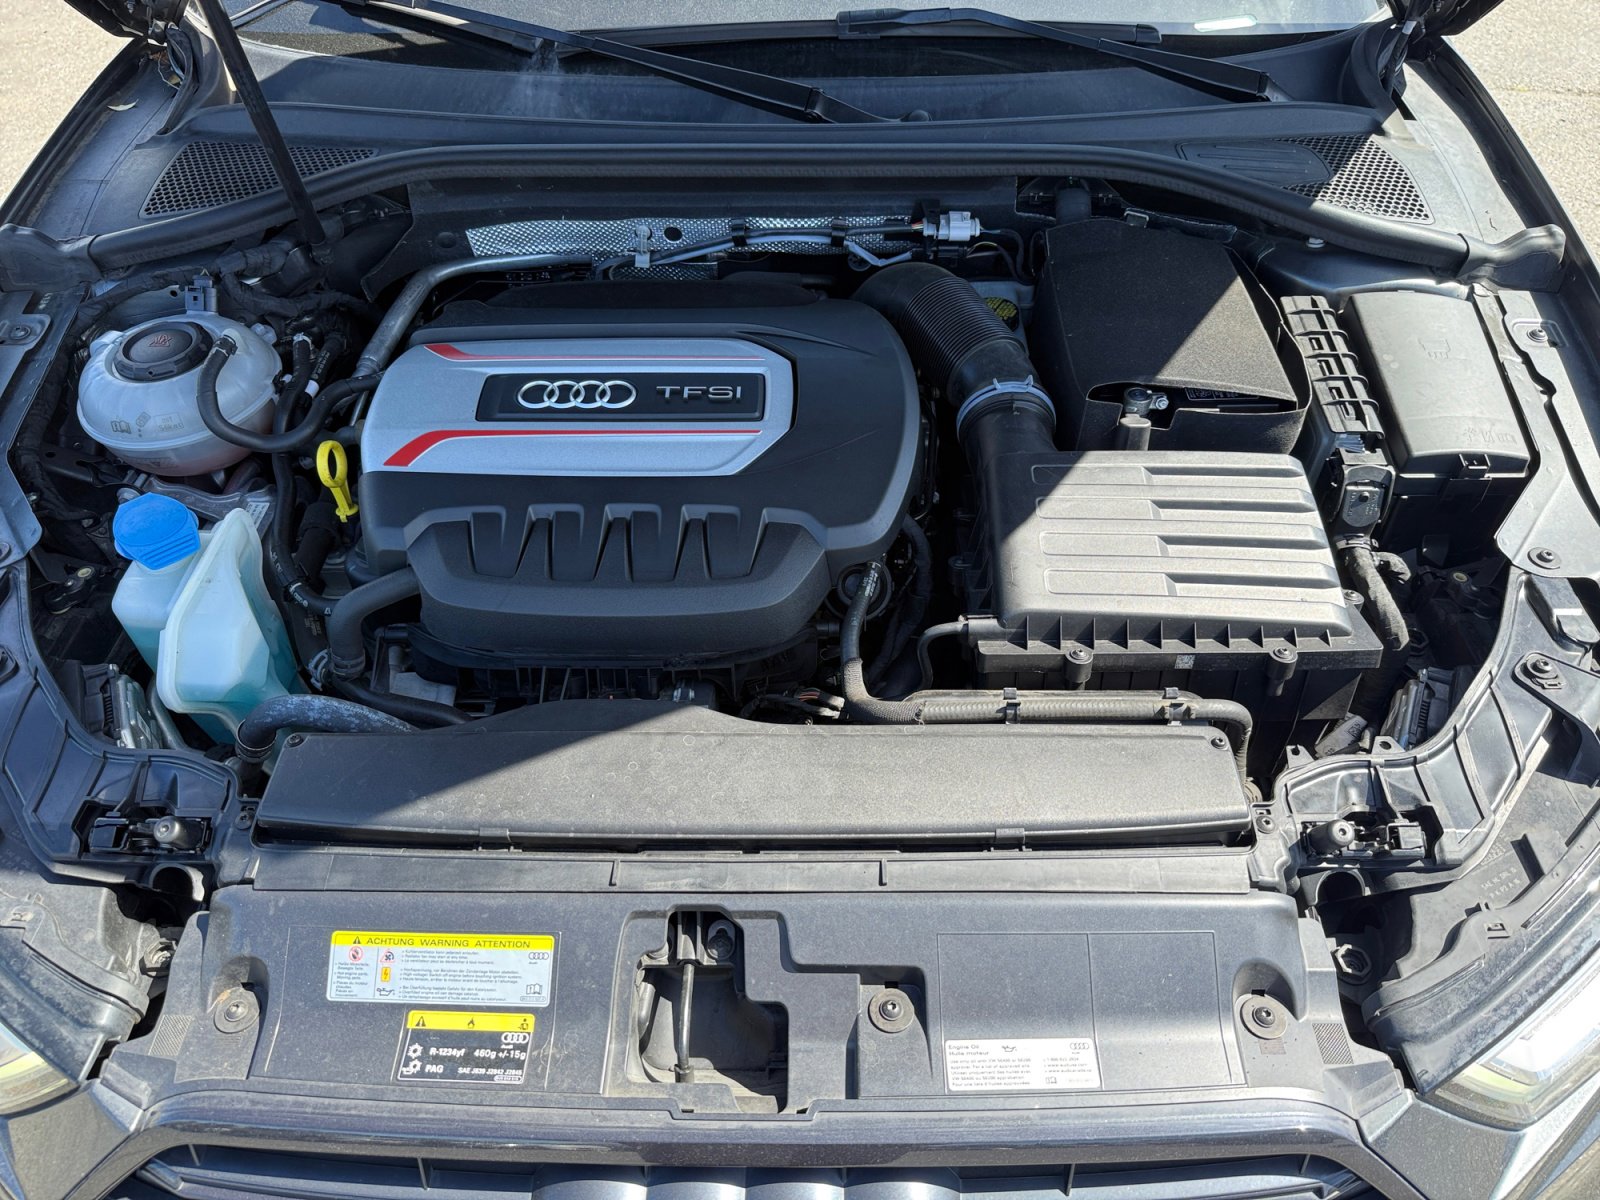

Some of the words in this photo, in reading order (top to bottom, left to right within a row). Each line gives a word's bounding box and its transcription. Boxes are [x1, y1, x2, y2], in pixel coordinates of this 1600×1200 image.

[656, 385, 742, 401] TFSI
[366, 937, 415, 946] ACHTUNG
[420, 938, 469, 948] WARNING
[474, 939, 531, 949] ATTENTION
[429, 1047, 466, 1058] R-1234yf
[473, 1048, 497, 1060] 460g
[425, 1064, 445, 1073] PAG
[457, 1066, 471, 1074] SAE
